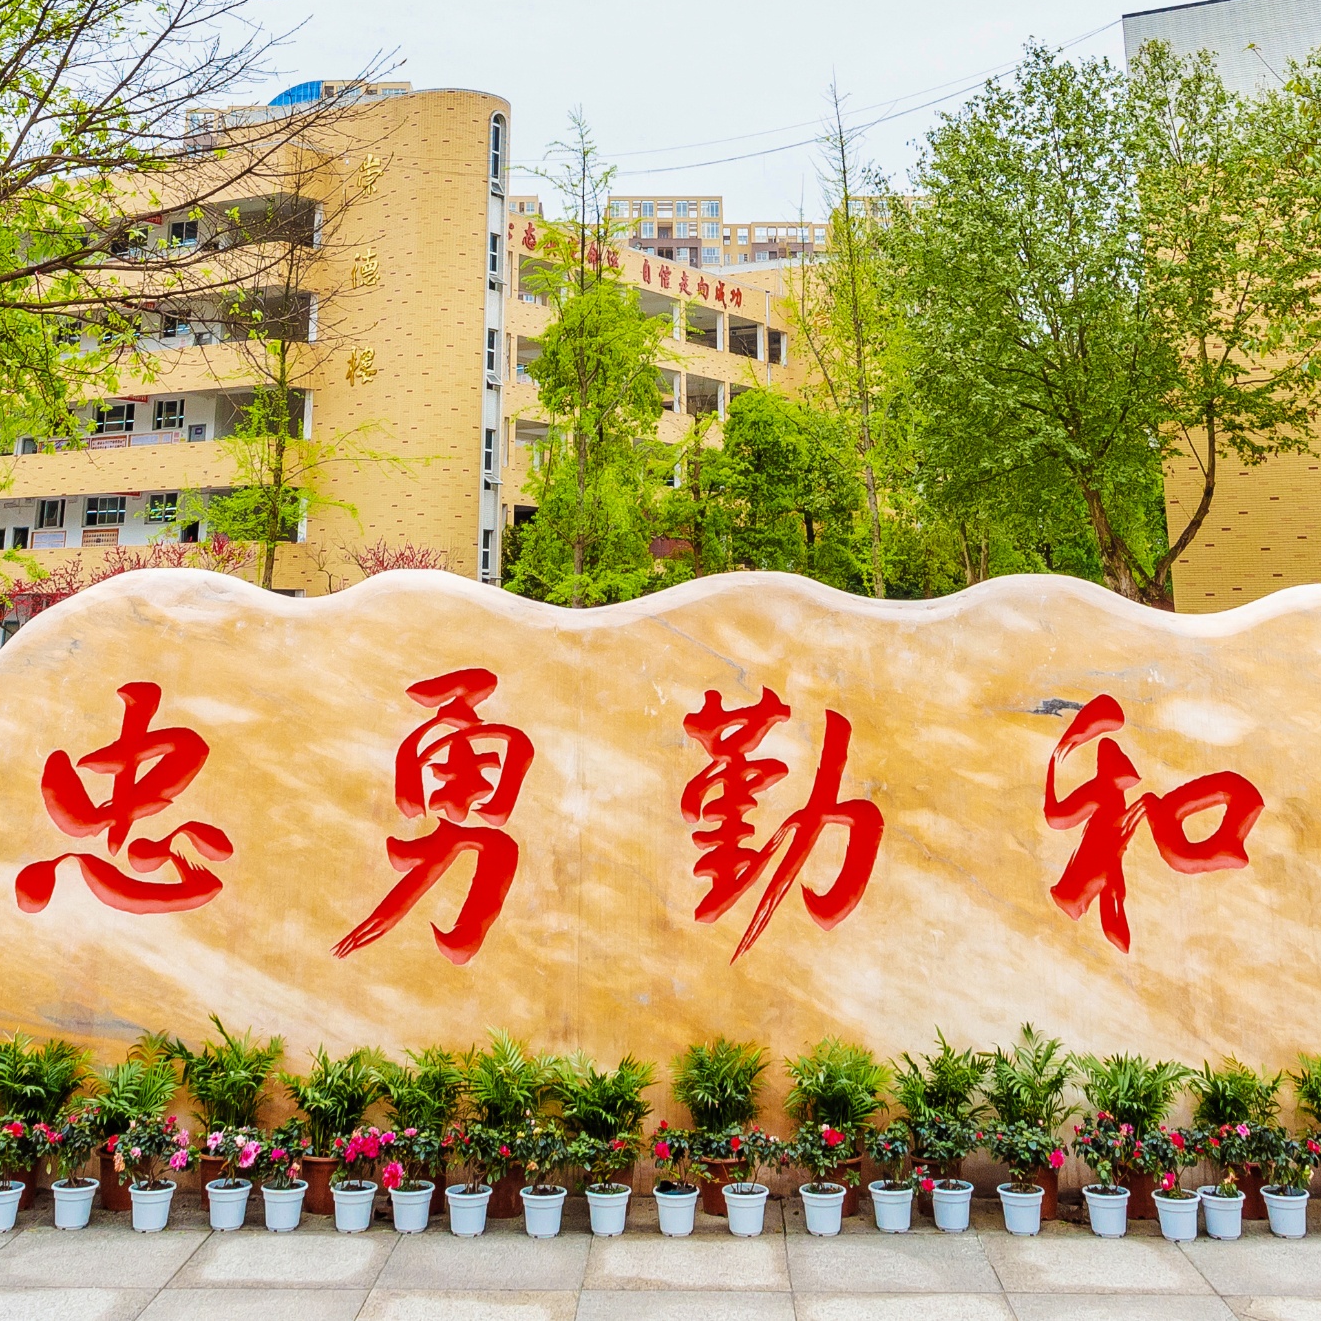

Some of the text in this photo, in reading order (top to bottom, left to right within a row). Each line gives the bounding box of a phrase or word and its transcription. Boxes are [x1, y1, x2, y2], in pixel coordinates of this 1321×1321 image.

[643, 258, 743, 309] 自信走向成功
[16, 668, 1265, 964] 忠勇勤和
